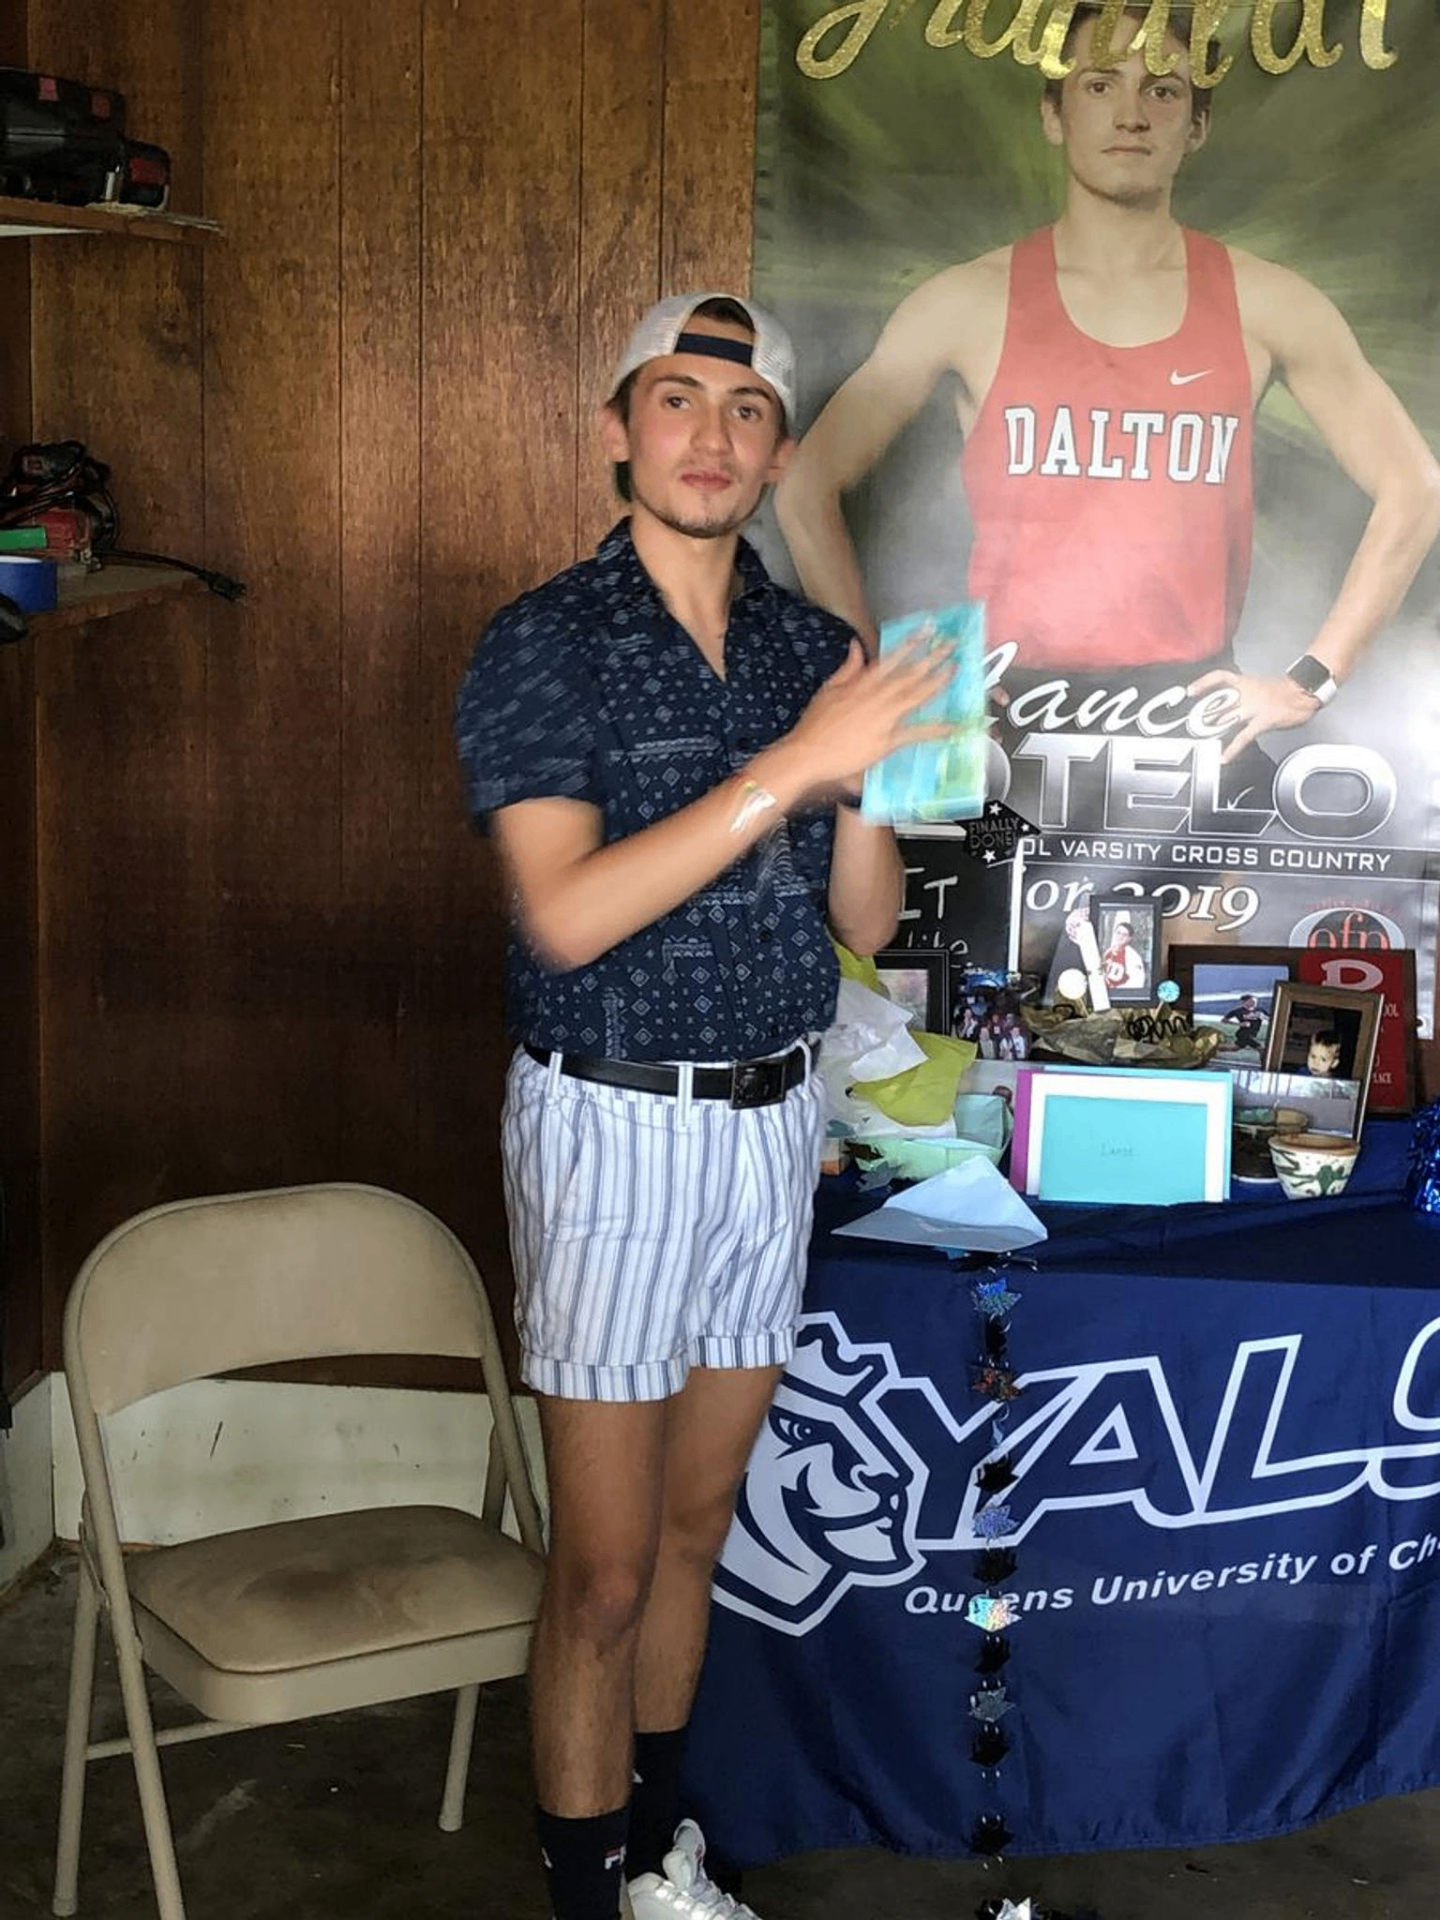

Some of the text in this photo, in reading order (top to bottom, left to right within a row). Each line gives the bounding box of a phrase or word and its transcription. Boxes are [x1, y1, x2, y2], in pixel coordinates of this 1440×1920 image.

[1003, 405, 1240, 485] DALTON
[968, 817, 1019, 835] FINALLY
[1061, 839, 1162, 861] VARSITY
[1172, 845, 1258, 865] CROSS
[1270, 849, 1392, 872] COUNTRY
[1091, 1551, 1318, 1606] University
[1330, 1545, 1378, 1576] of
